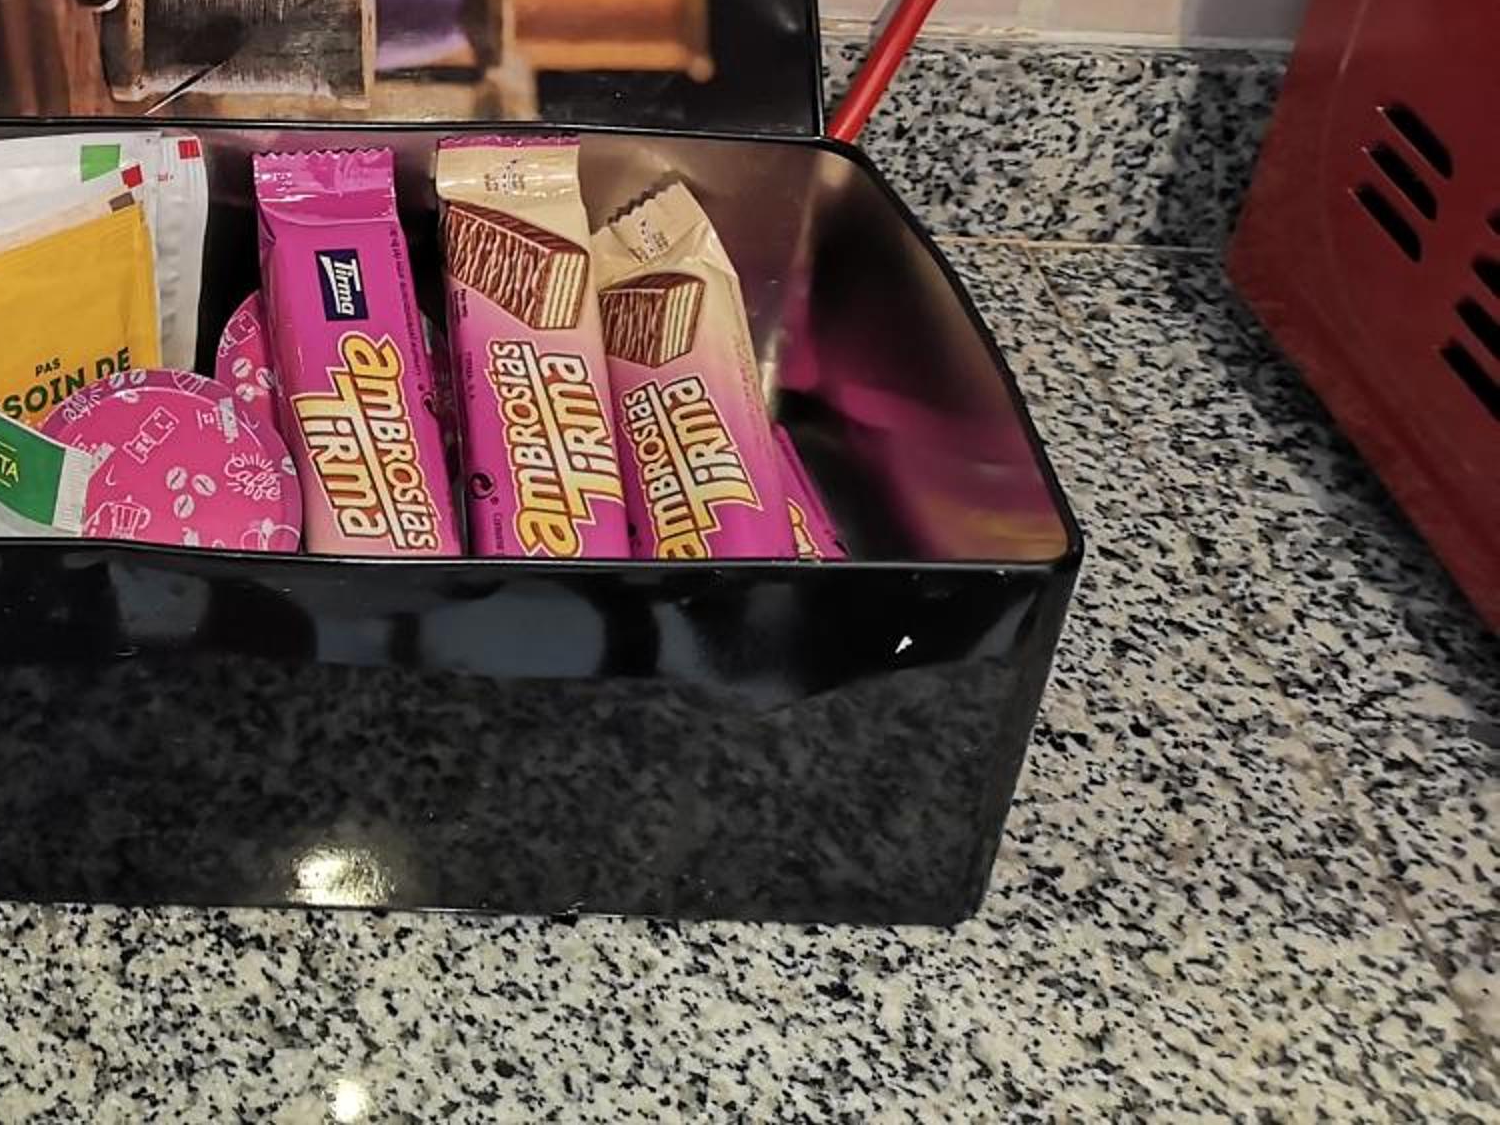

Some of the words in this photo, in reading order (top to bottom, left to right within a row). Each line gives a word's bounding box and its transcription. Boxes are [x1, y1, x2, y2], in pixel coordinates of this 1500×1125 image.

[331, 257, 362, 316] Tirma
[35, 358, 60, 377] PAS
[96, 347, 131, 379] DE
